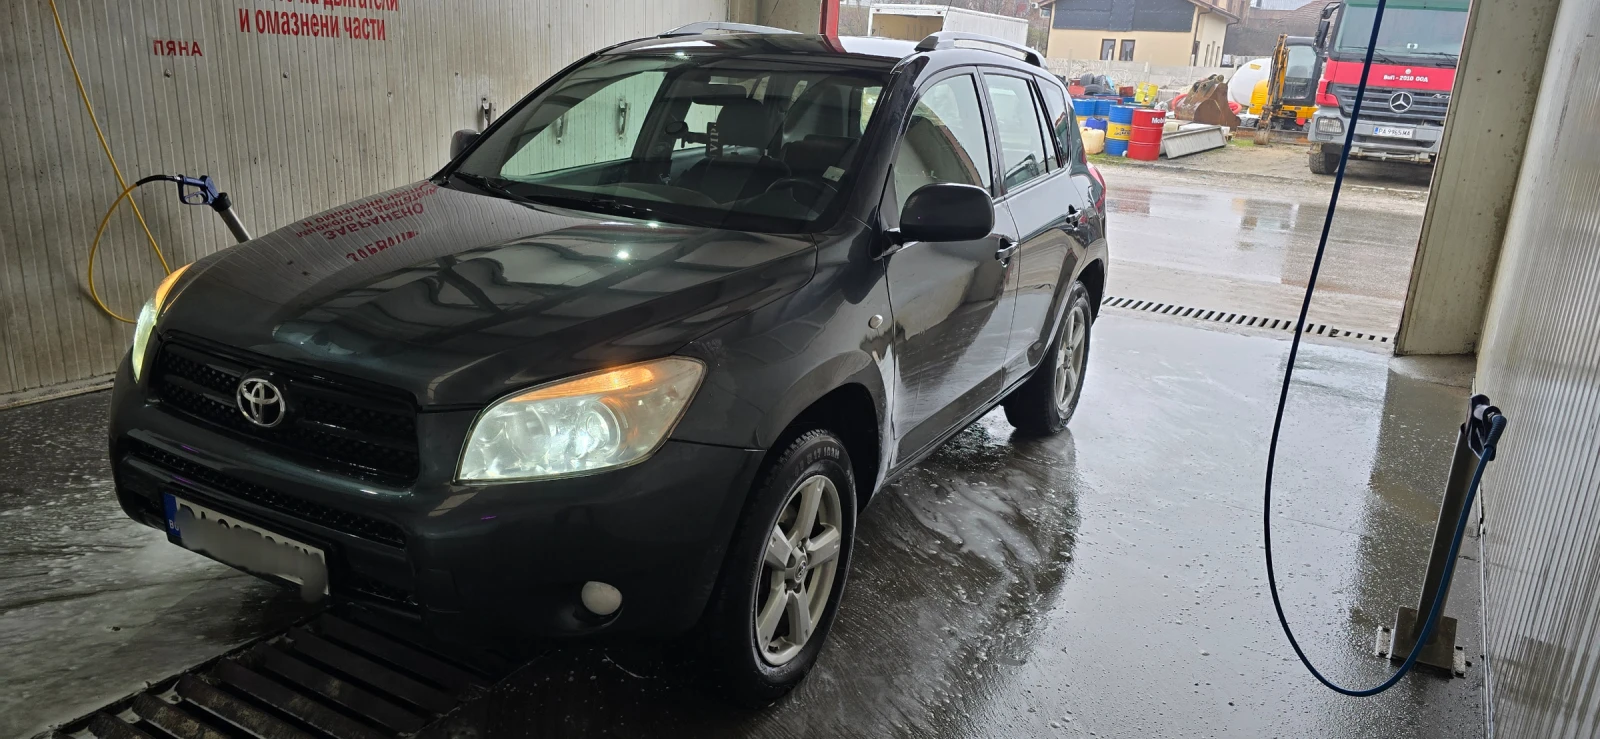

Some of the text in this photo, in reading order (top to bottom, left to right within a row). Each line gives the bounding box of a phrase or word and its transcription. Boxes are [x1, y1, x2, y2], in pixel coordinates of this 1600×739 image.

[239, 8, 386, 41] и омазнени части
[153, 40, 203, 57] ПЯНА
